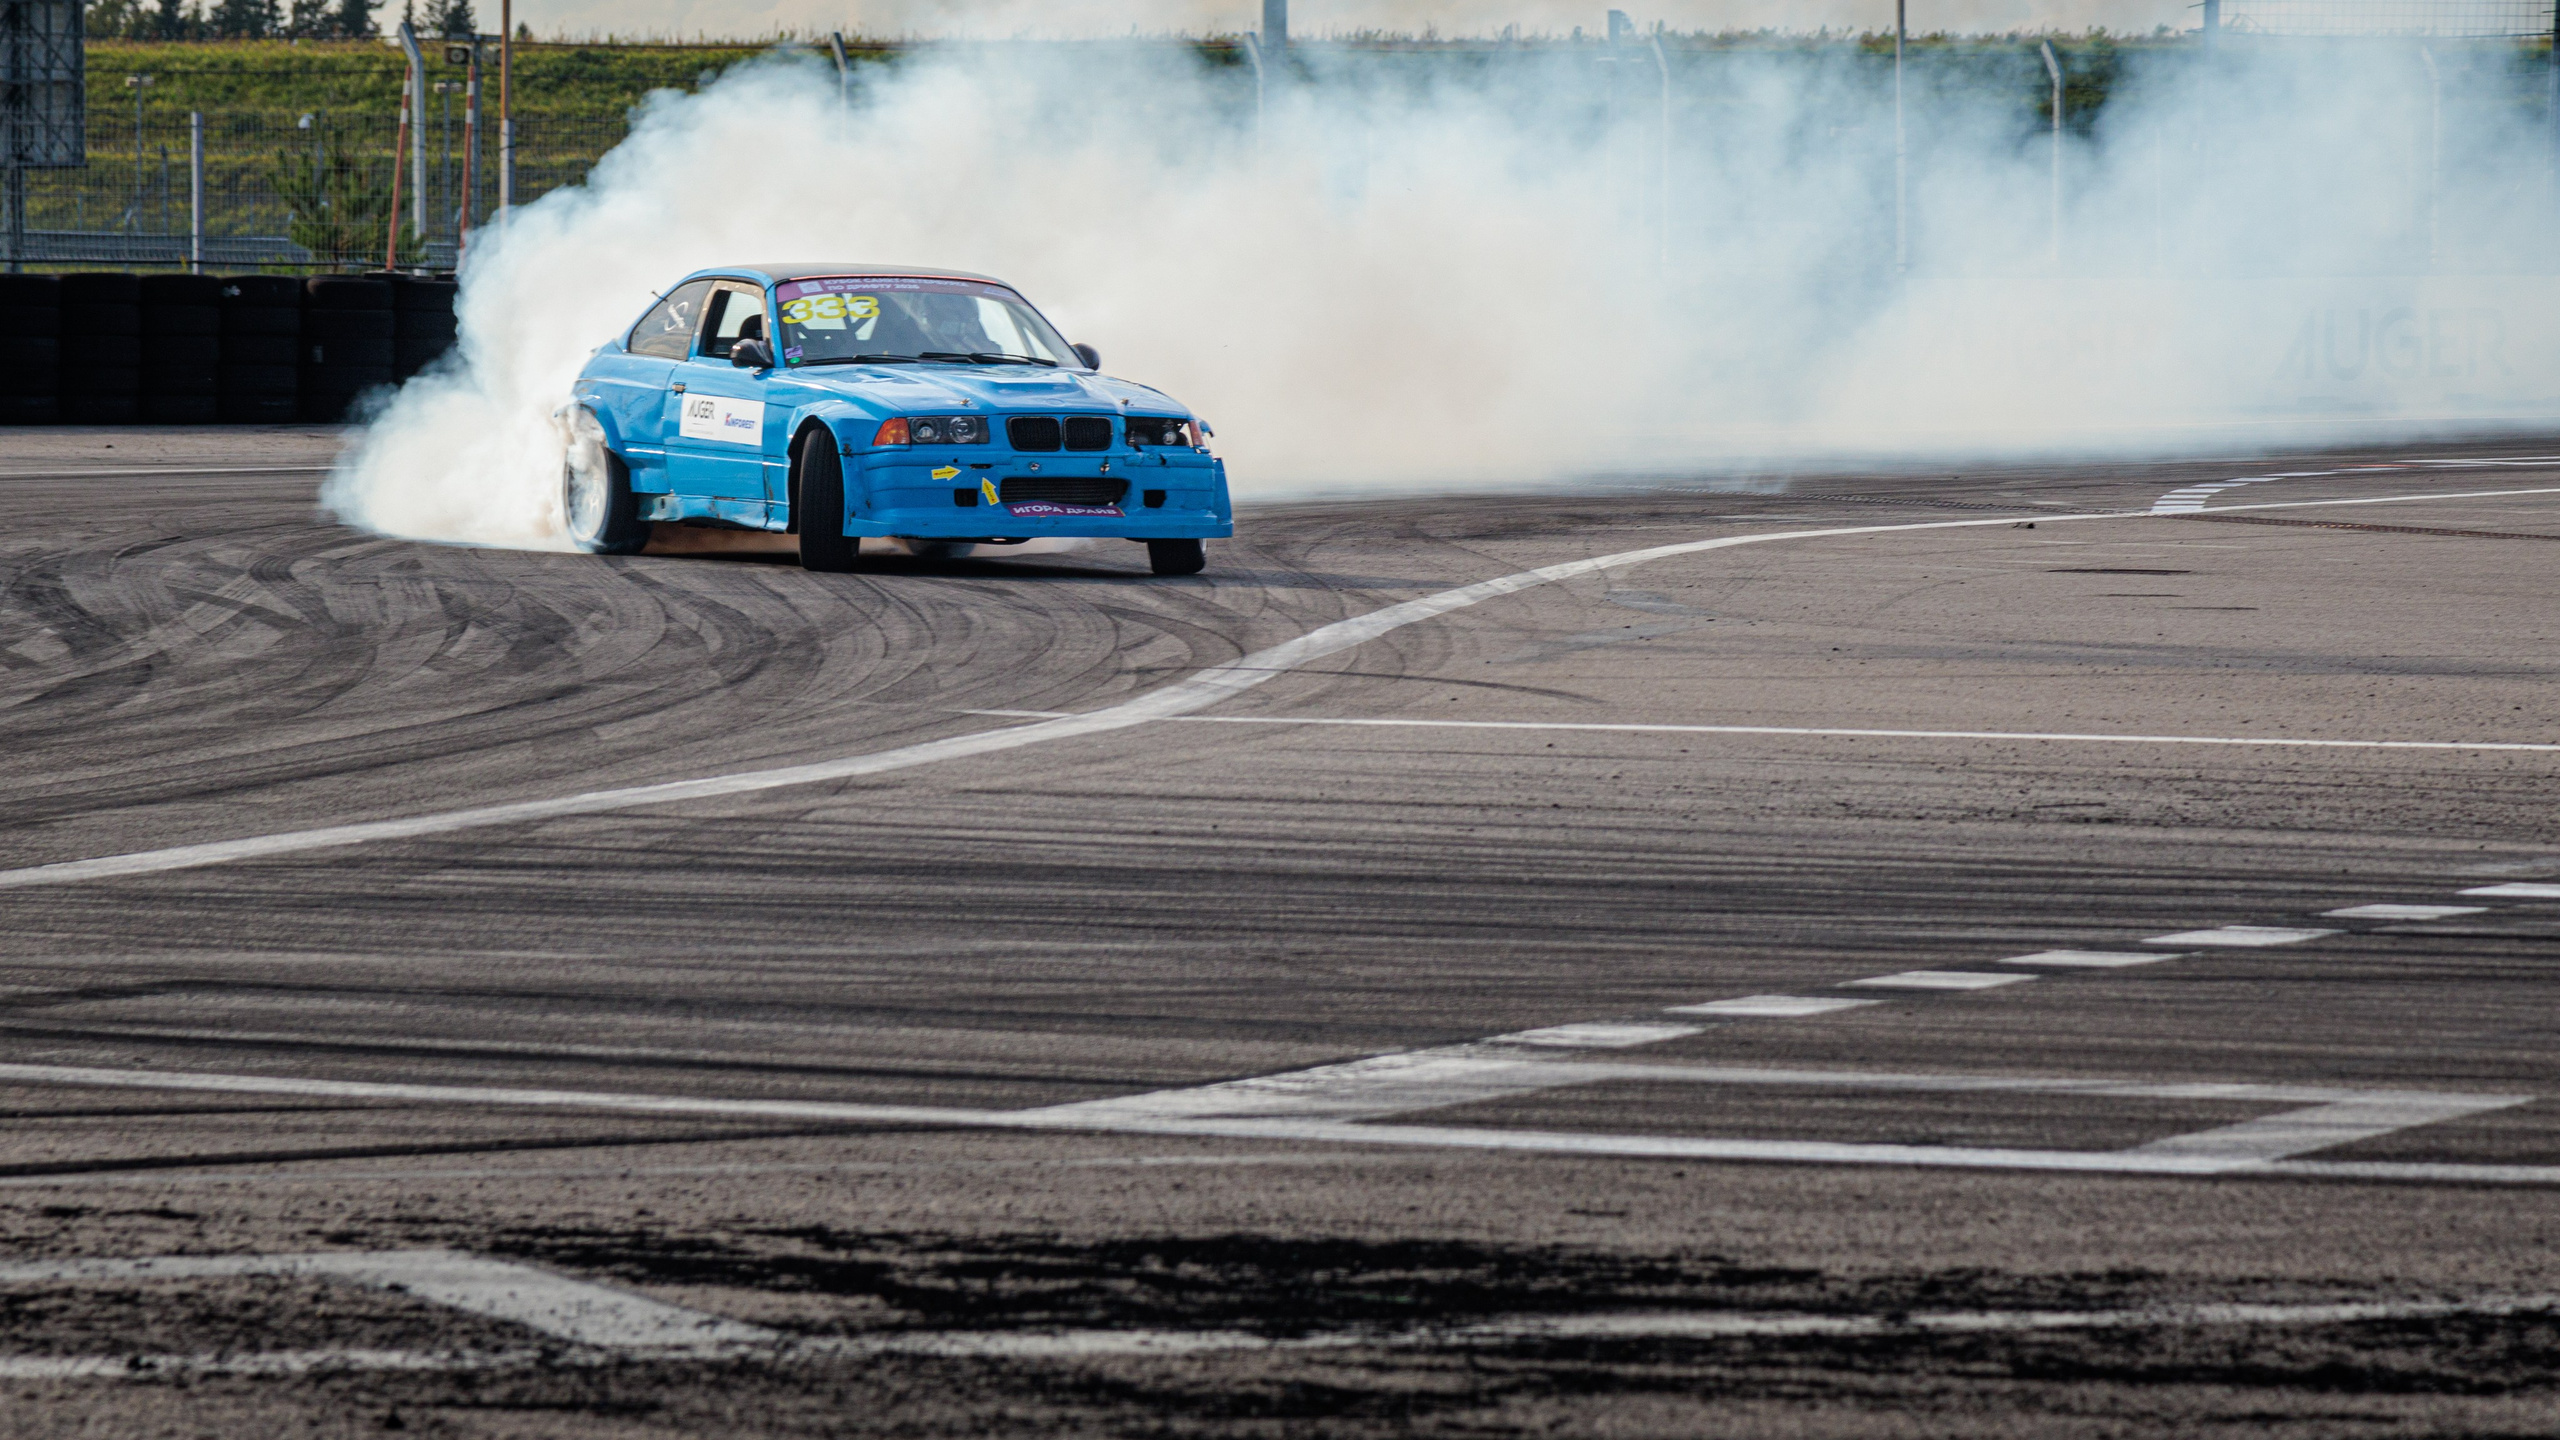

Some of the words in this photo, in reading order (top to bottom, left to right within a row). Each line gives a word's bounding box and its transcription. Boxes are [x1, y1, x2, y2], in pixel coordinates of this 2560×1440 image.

[781, 296, 880, 324] 333
[2277, 306, 2516, 382] AUGER
[687, 400, 715, 419] AUGER
[1013, 505, 1063, 514] ИГОРА
